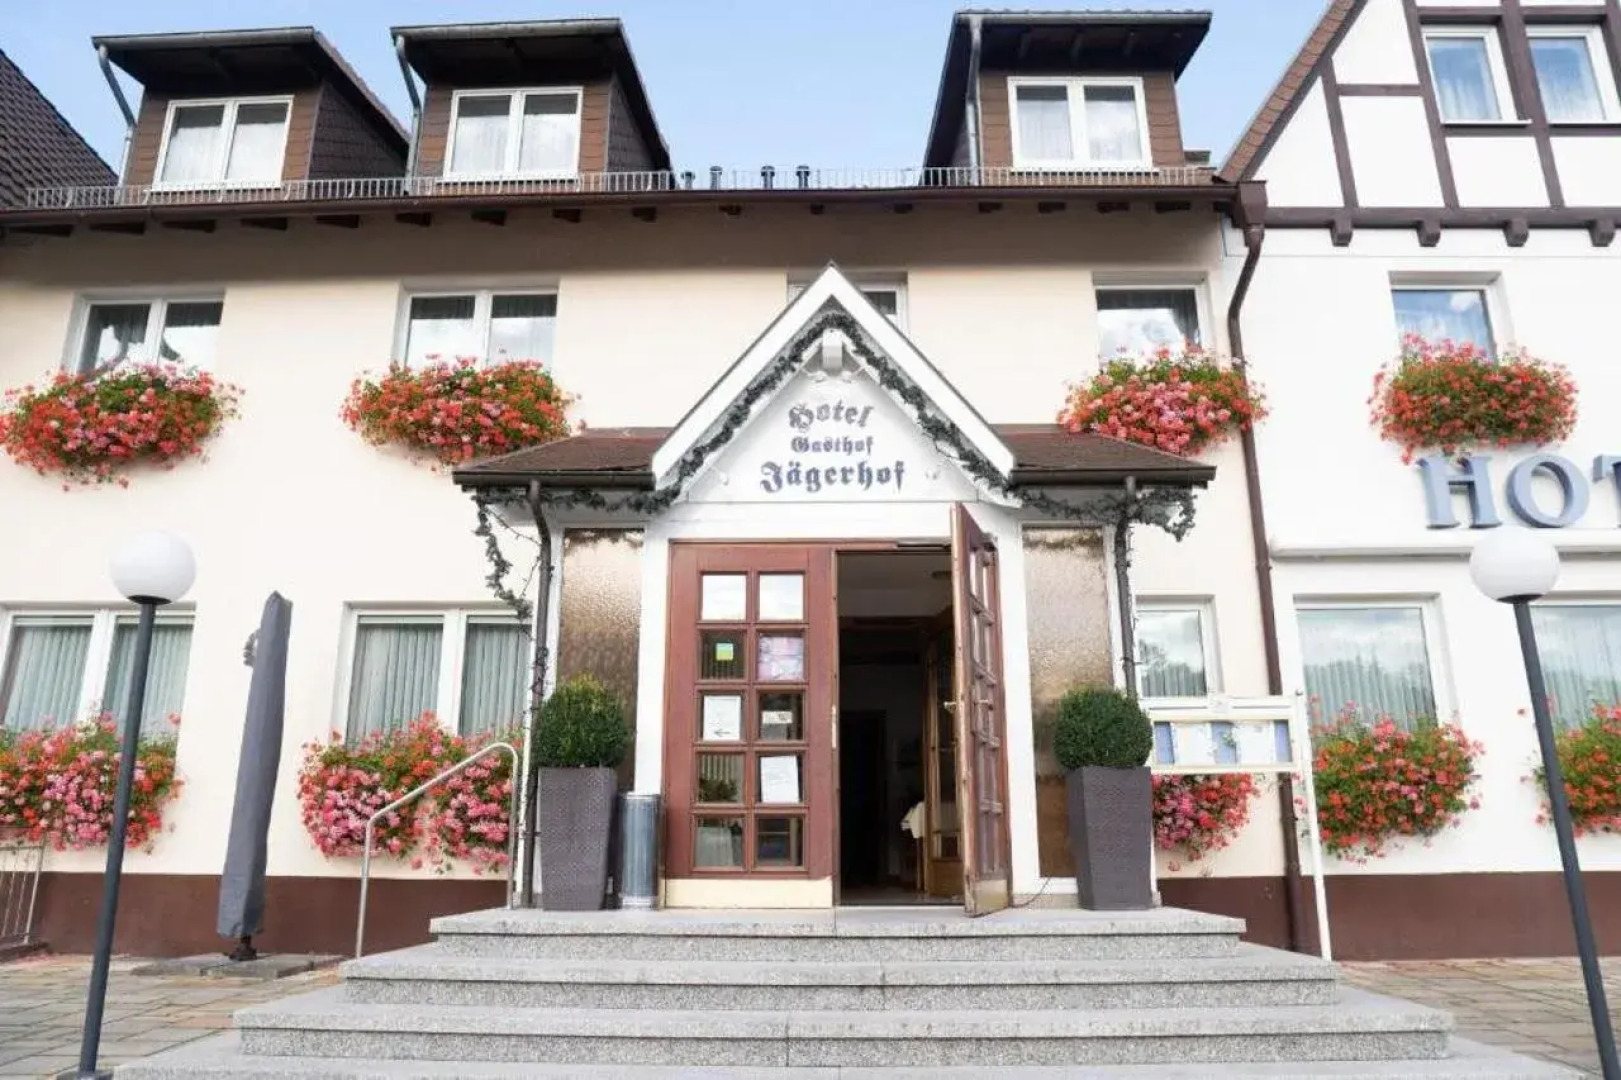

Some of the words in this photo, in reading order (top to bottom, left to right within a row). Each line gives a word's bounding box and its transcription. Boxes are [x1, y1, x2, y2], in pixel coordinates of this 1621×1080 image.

[788, 400, 874, 433] Hotel
[791, 435, 873, 456] Gasthof
[760, 460, 904, 493] Jägerhof
